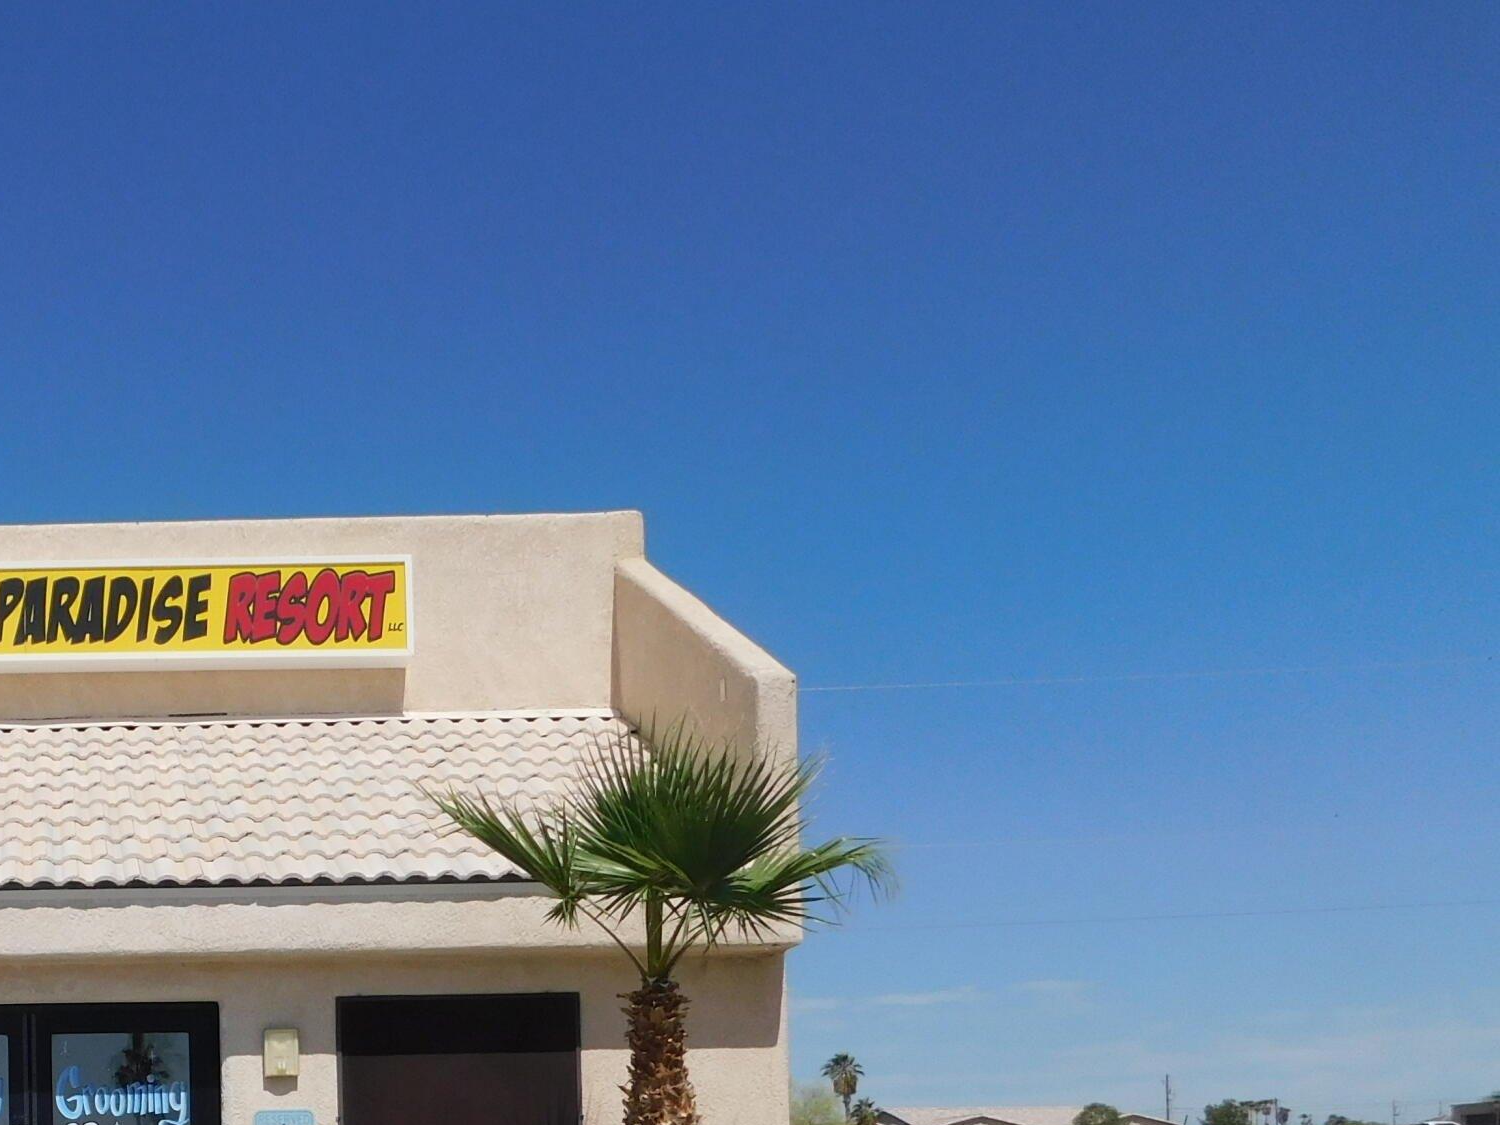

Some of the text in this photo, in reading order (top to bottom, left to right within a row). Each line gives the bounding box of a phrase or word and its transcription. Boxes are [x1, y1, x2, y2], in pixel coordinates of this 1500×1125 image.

[223, 568, 395, 645] RESORT
[388, 622, 403, 632] LLC
[258, 1113, 311, 1125] RESERVED
